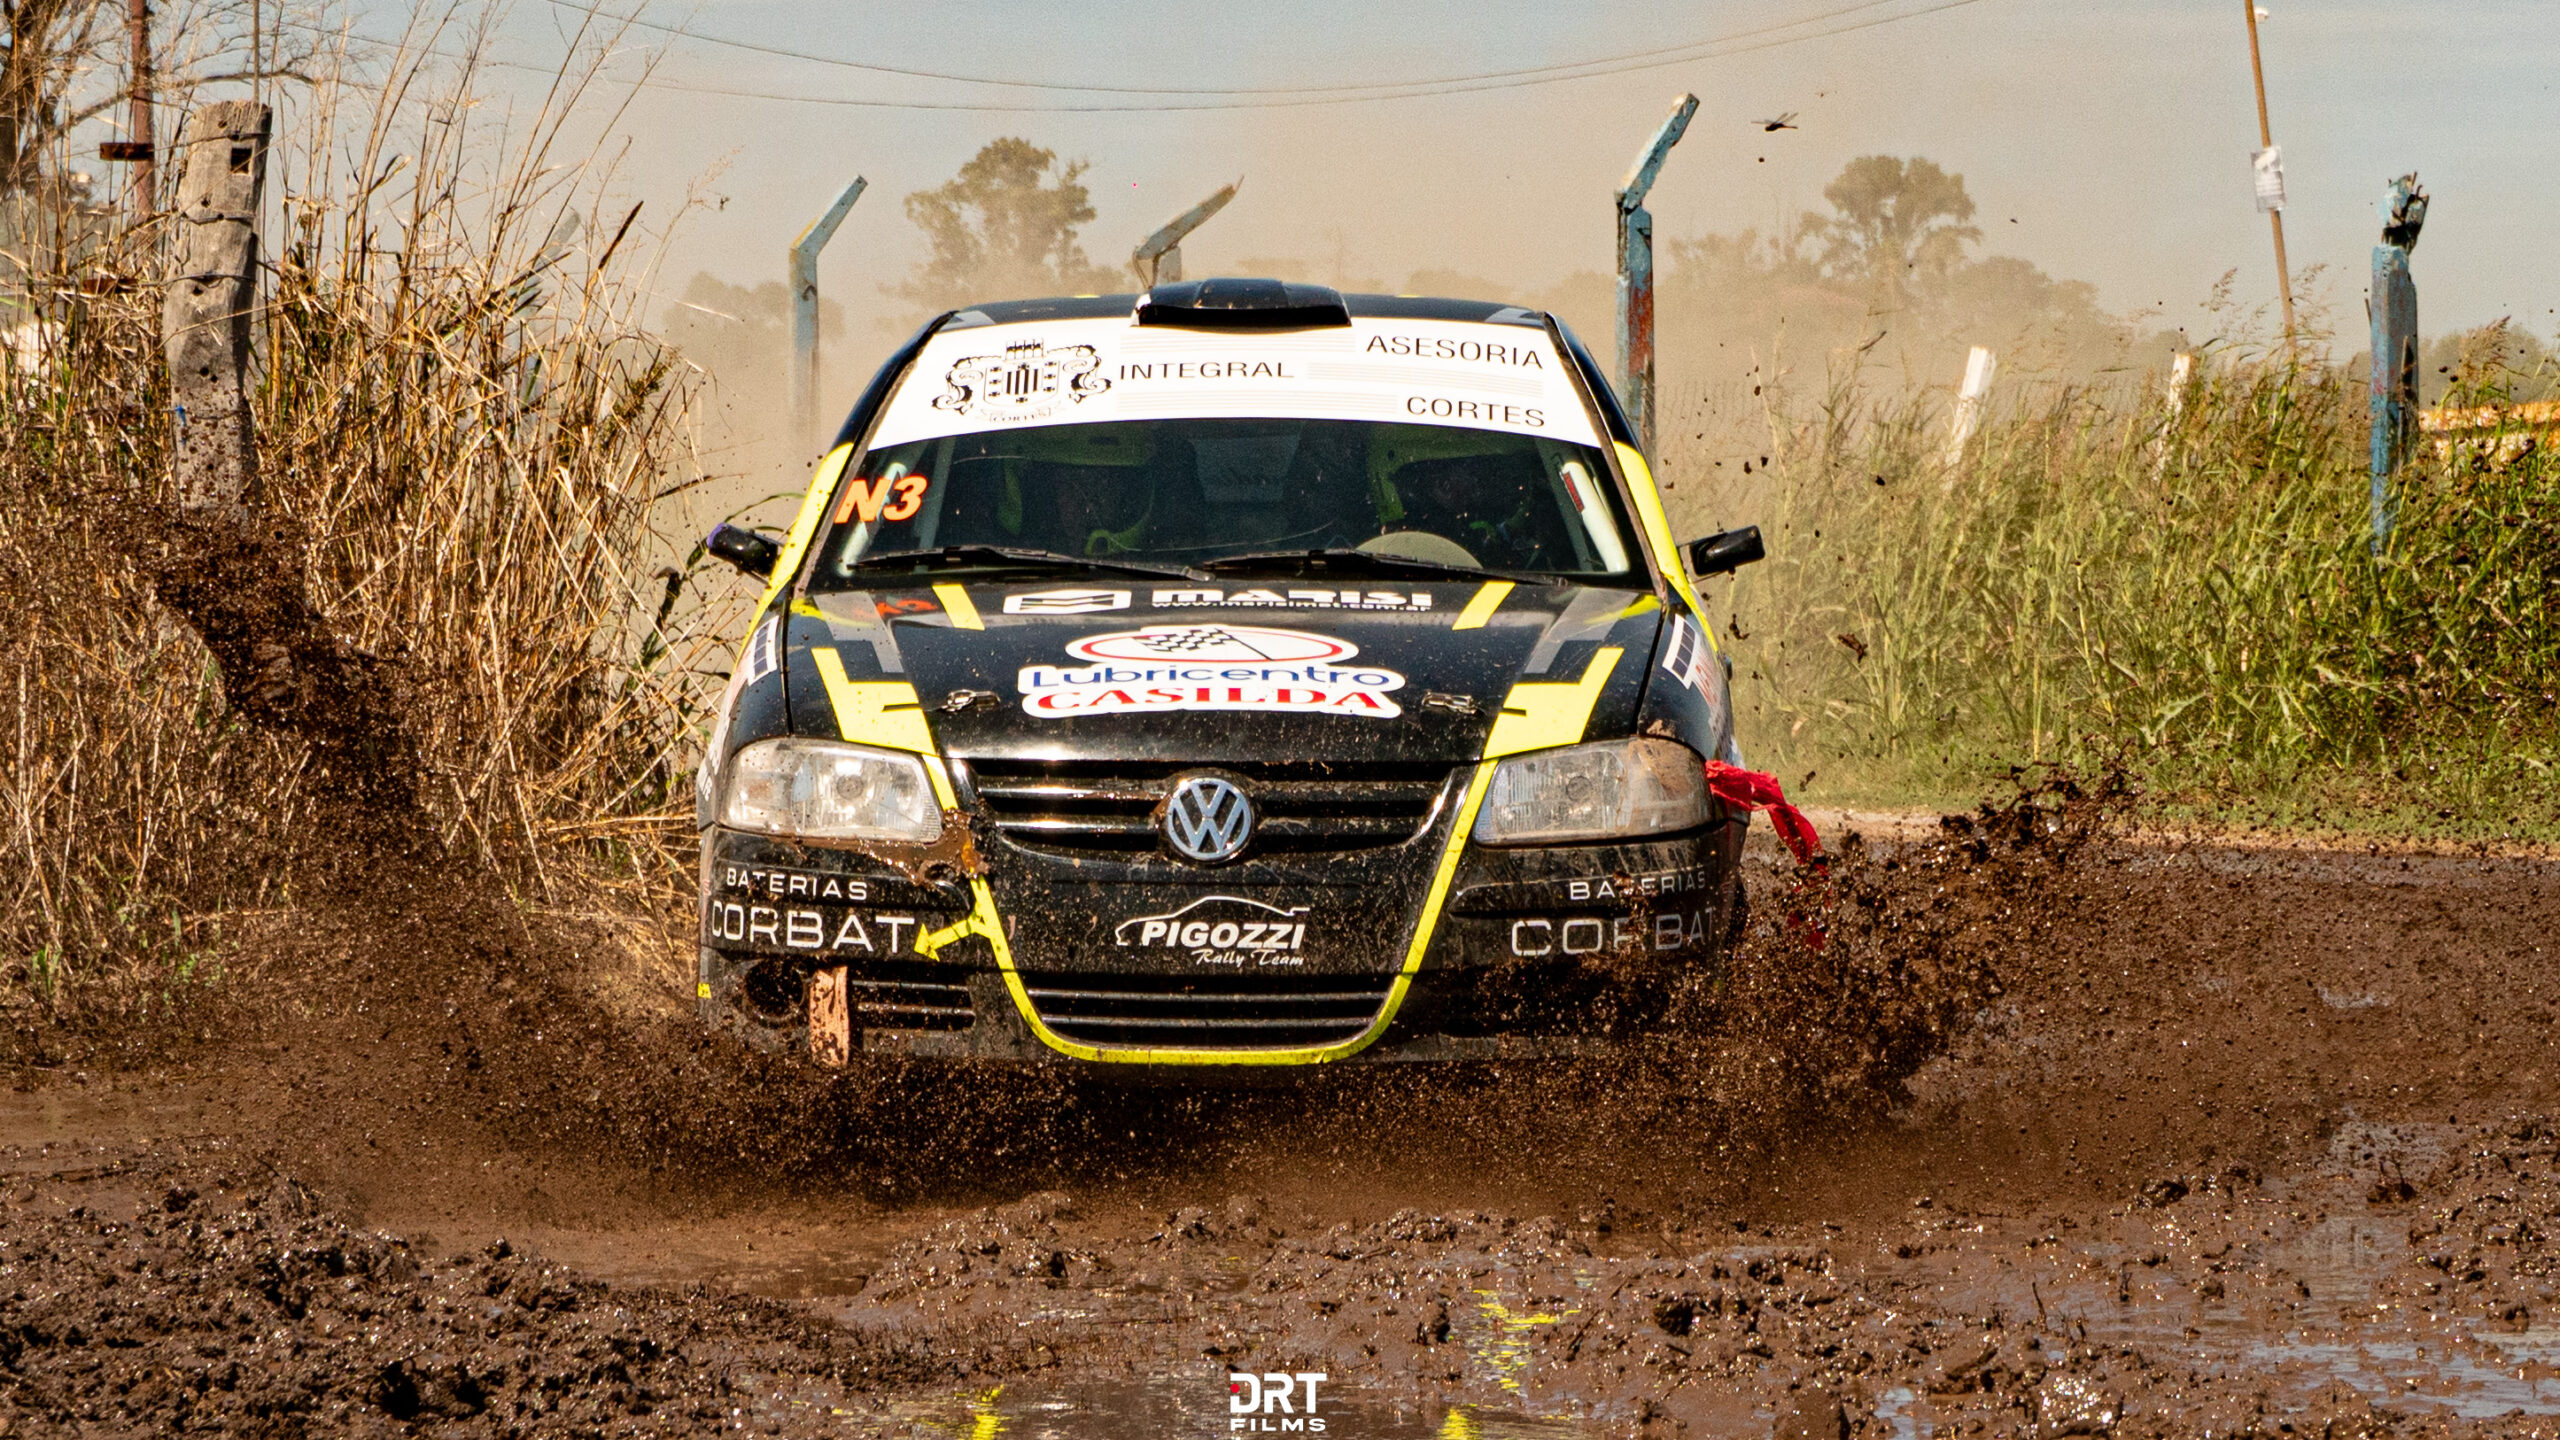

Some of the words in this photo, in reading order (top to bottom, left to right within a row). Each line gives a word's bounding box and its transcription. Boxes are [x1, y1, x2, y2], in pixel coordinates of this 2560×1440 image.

[1366, 335, 1543, 369] ASESORIA
[1120, 361, 1294, 380] INTEGRAL
[1407, 396, 1545, 428] CORTES
[833, 473, 928, 524] N3
[1033, 664, 1390, 688] Lubricentro
[1037, 687, 1382, 711] CASILDA
[1569, 871, 1705, 900] BAERIAS
[712, 900, 915, 953] CORBAT
[1141, 921, 1306, 949] PIGOZZI
[1191, 949, 1245, 968] Rally
[1251, 949, 1304, 966] Team
